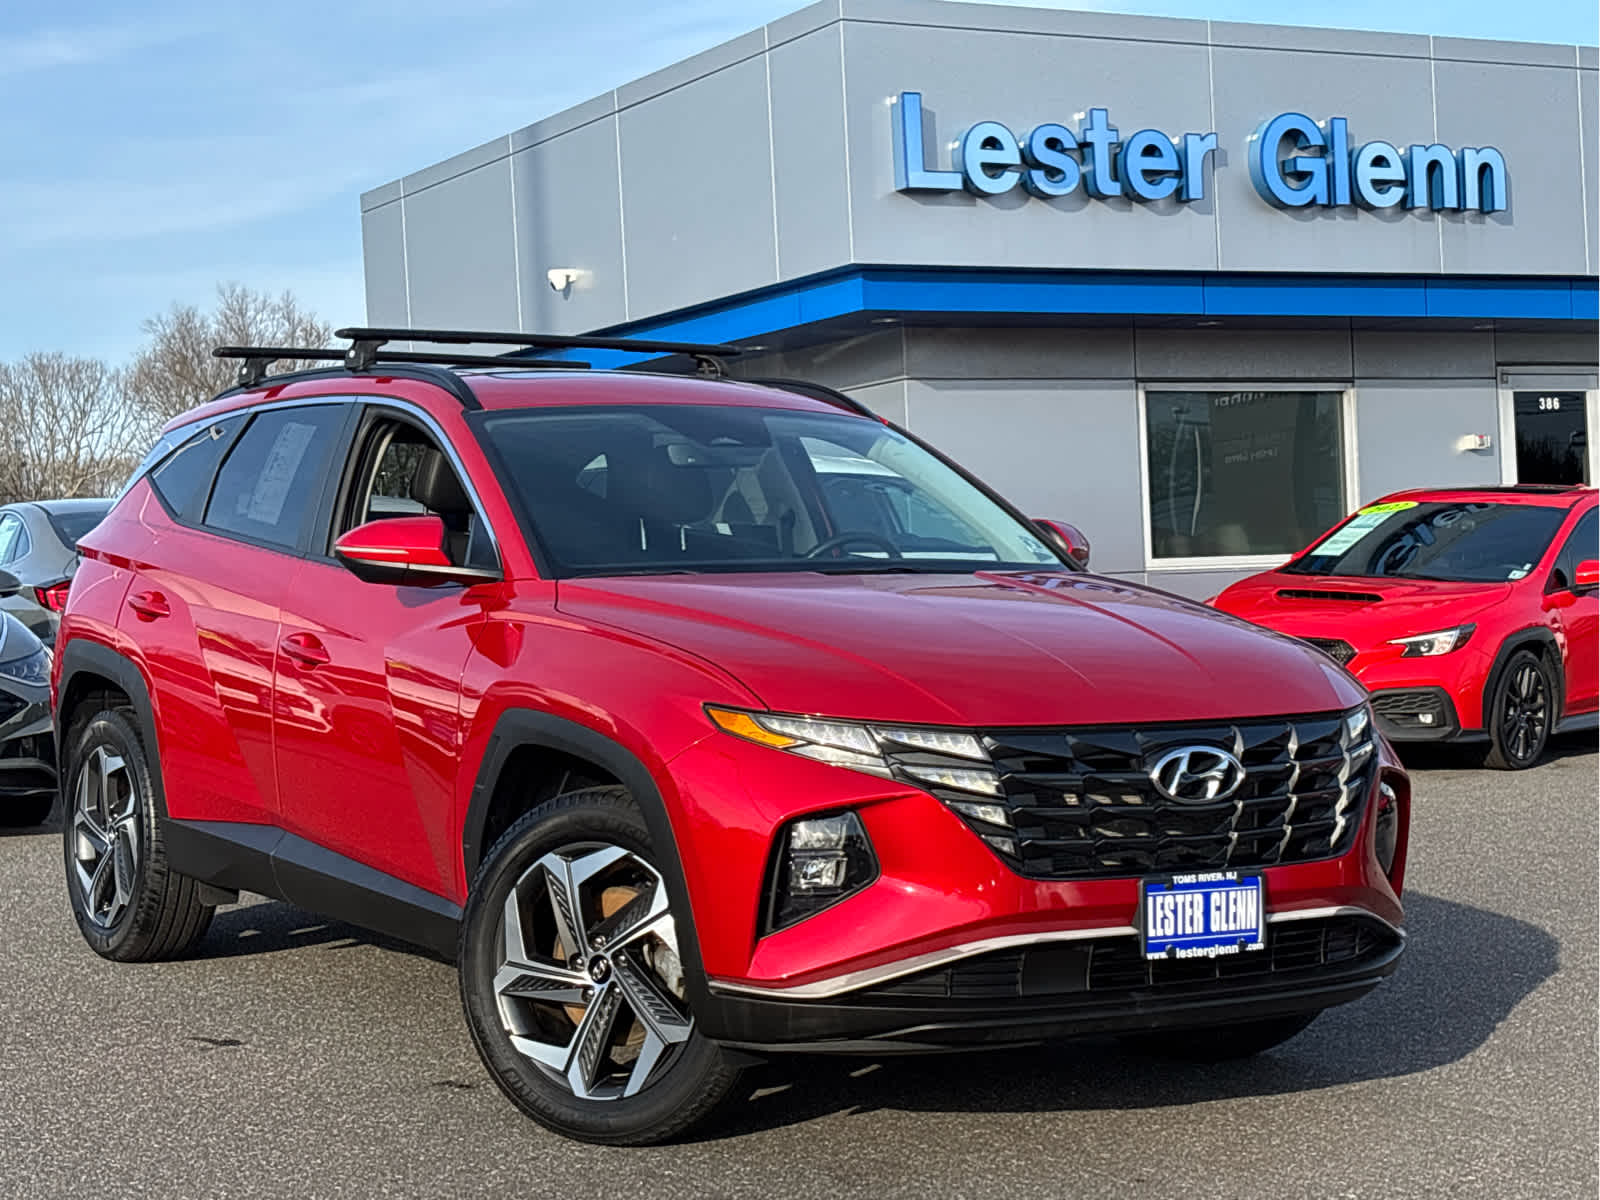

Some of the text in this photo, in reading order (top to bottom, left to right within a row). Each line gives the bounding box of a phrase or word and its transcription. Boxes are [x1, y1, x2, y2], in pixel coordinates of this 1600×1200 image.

[891, 91, 1507, 213] Lester Glenn
[1539, 397, 1560, 410] 386
[1172, 875, 1197, 885] TOMS
[1226, 871, 1238, 880] NJ
[1147, 889, 1258, 937] LESTER GLENN
[1175, 944, 1240, 959] lesterglenn
